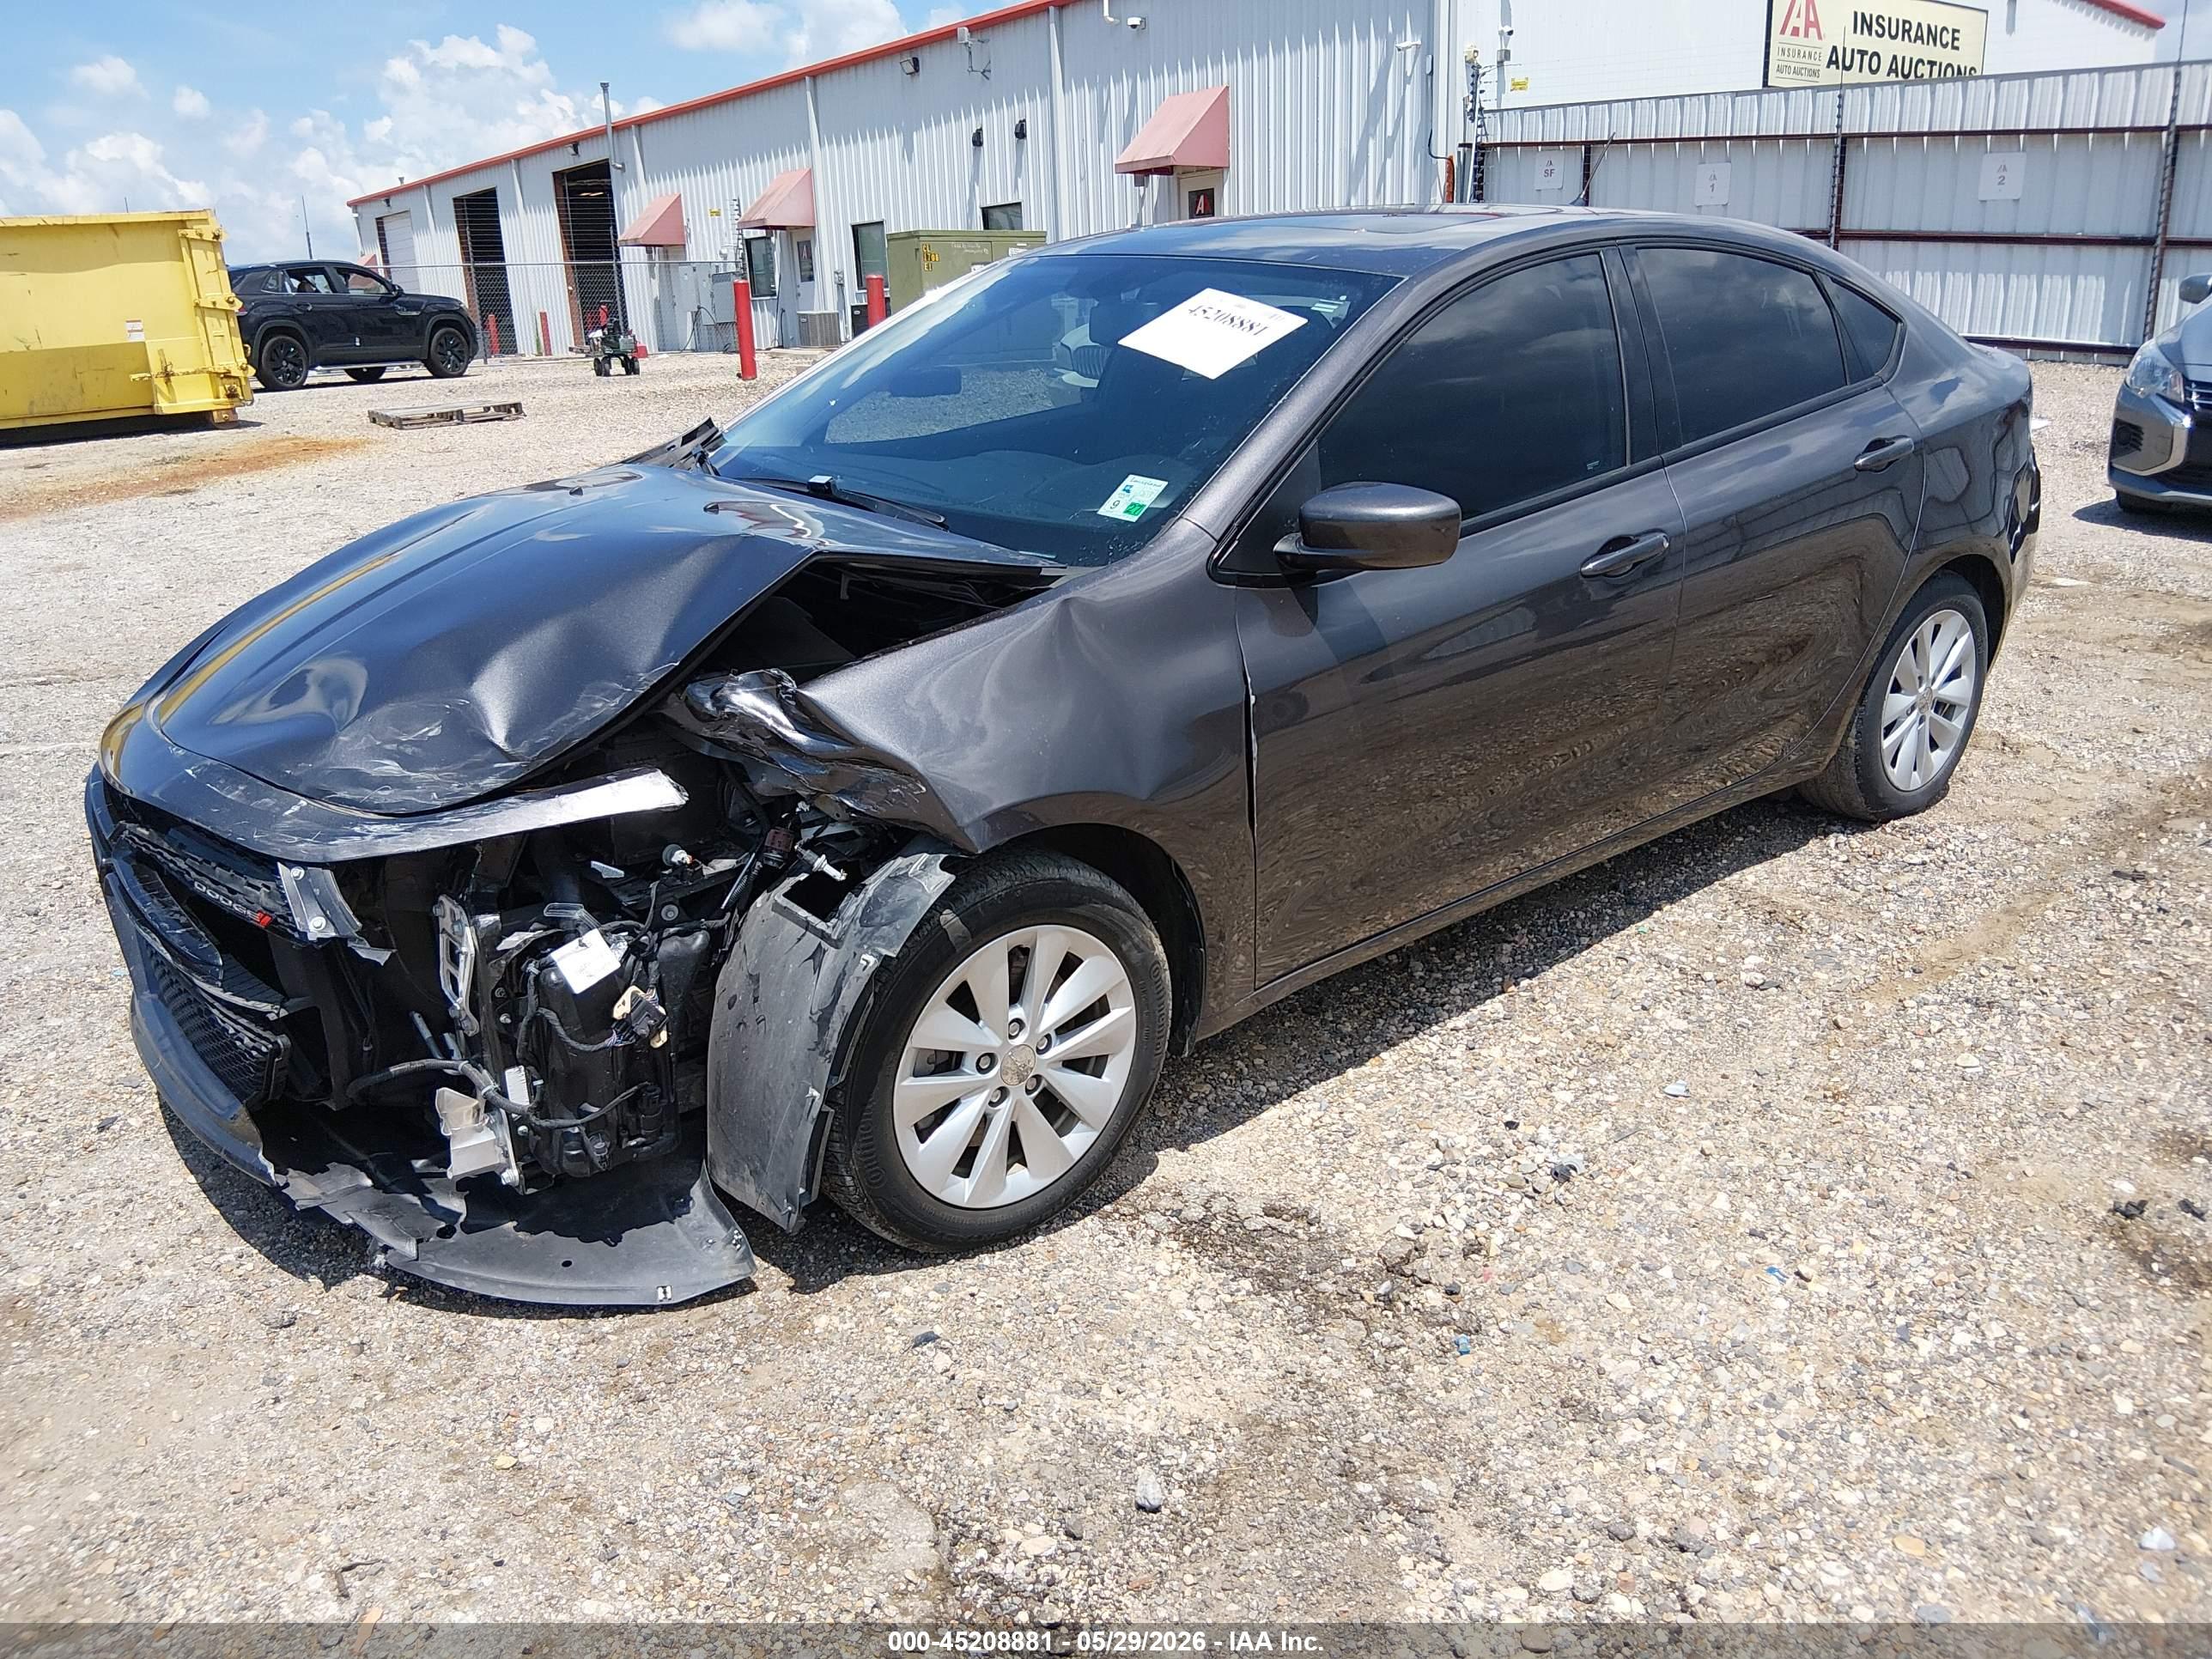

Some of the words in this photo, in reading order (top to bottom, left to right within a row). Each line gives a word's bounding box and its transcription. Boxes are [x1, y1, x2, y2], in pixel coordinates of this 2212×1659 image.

[1852, 10, 1961, 51] INSURANCE
[1777, 46, 1822, 61] INSURANCE
[1826, 45, 1881, 75] AUTO
[1776, 64, 1792, 75] AUTO
[1792, 66, 1820, 78] AUCTIONS
[1543, 168, 1556, 178] SF
[1997, 175, 2006, 185] 2
[194, 880, 261, 922] DODGE
